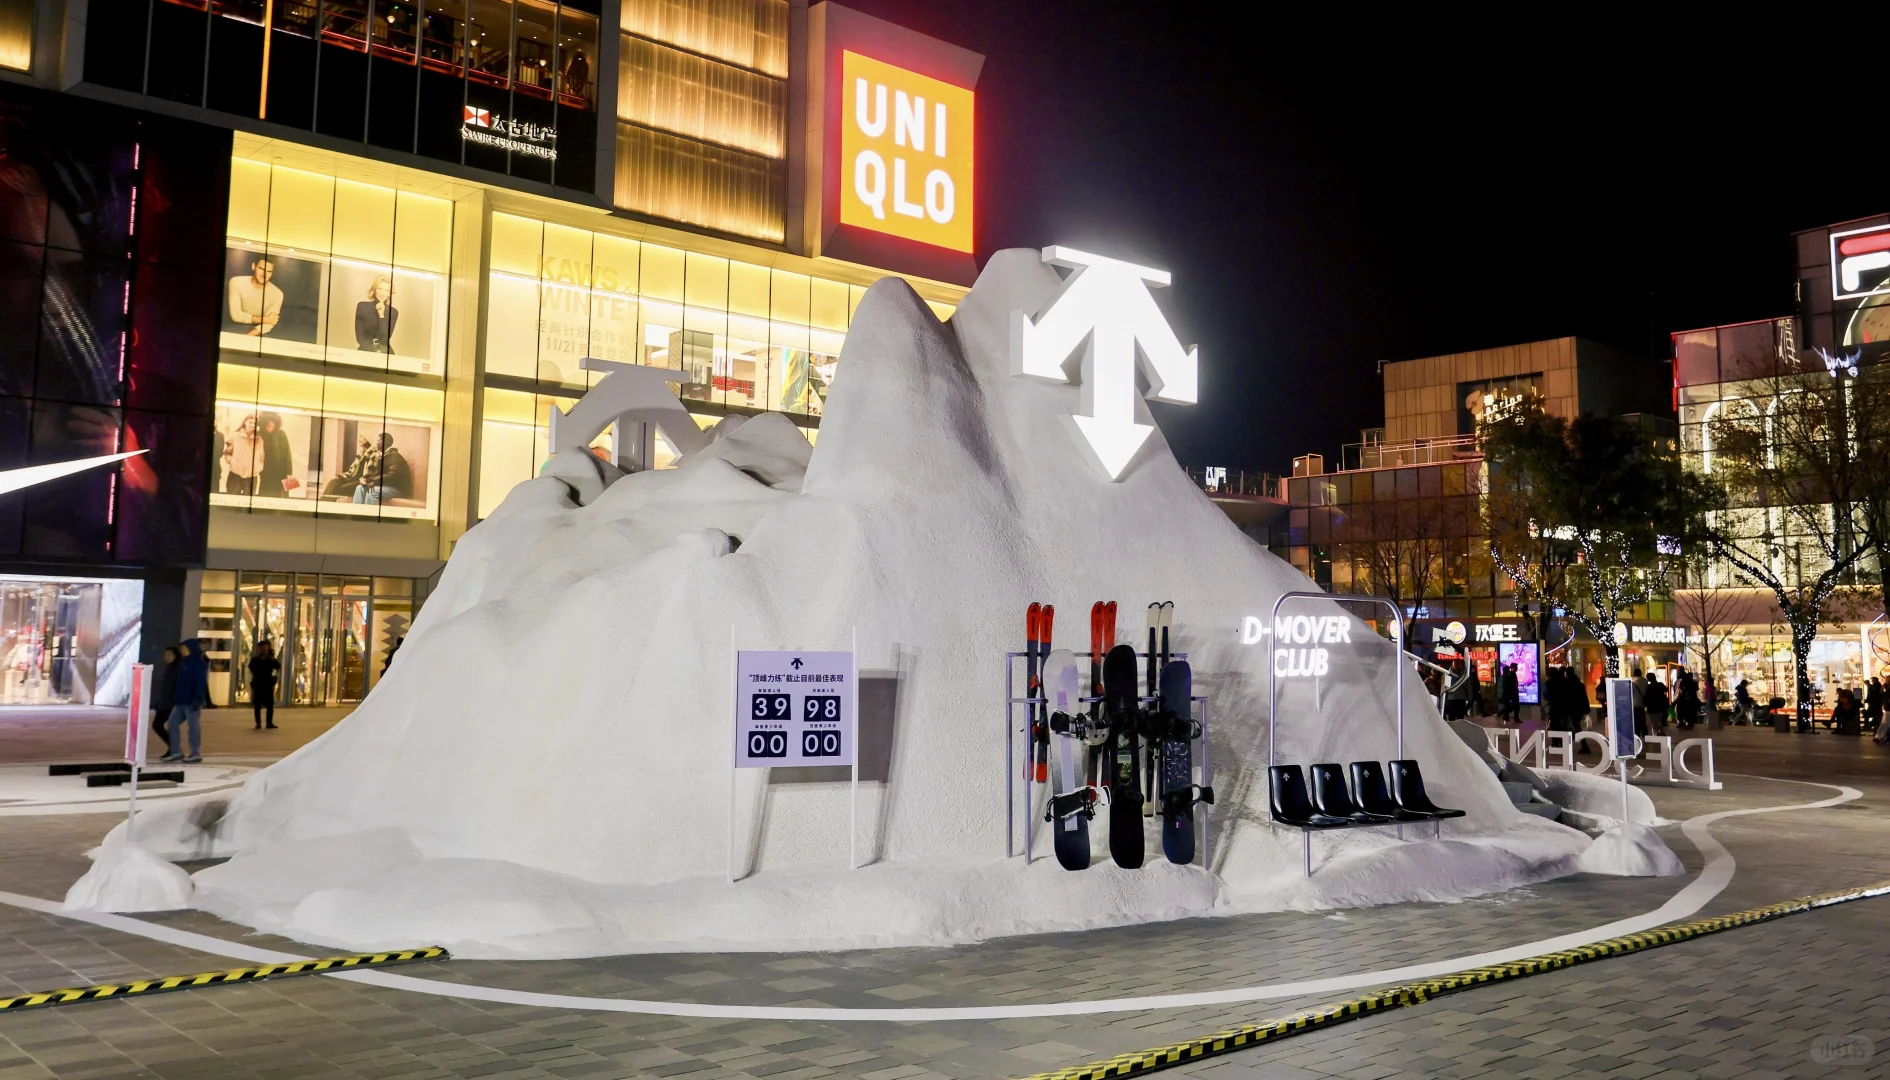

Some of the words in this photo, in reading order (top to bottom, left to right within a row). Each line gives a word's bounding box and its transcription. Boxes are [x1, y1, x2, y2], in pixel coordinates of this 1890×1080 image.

[491, 114, 557, 140] 太古地产
[855, 77, 947, 158] UNI
[461, 126, 496, 145] SWIRE
[496, 138, 557, 159] PROPERTIES
[854, 150, 955, 224] QLO
[536, 254, 619, 291] KAWS
[546, 337, 575, 353] 11/21
[1241, 615, 1351, 645] D-MOVER
[1475, 624, 1521, 641] 汉堡王
[1632, 626, 1674, 643] BURGER
[1274, 648, 1329, 677] CLUB
[754, 697, 788, 717] 39
[806, 699, 837, 718] 98
[750, 734, 785, 754] 00
[804, 733, 838, 753] 00
